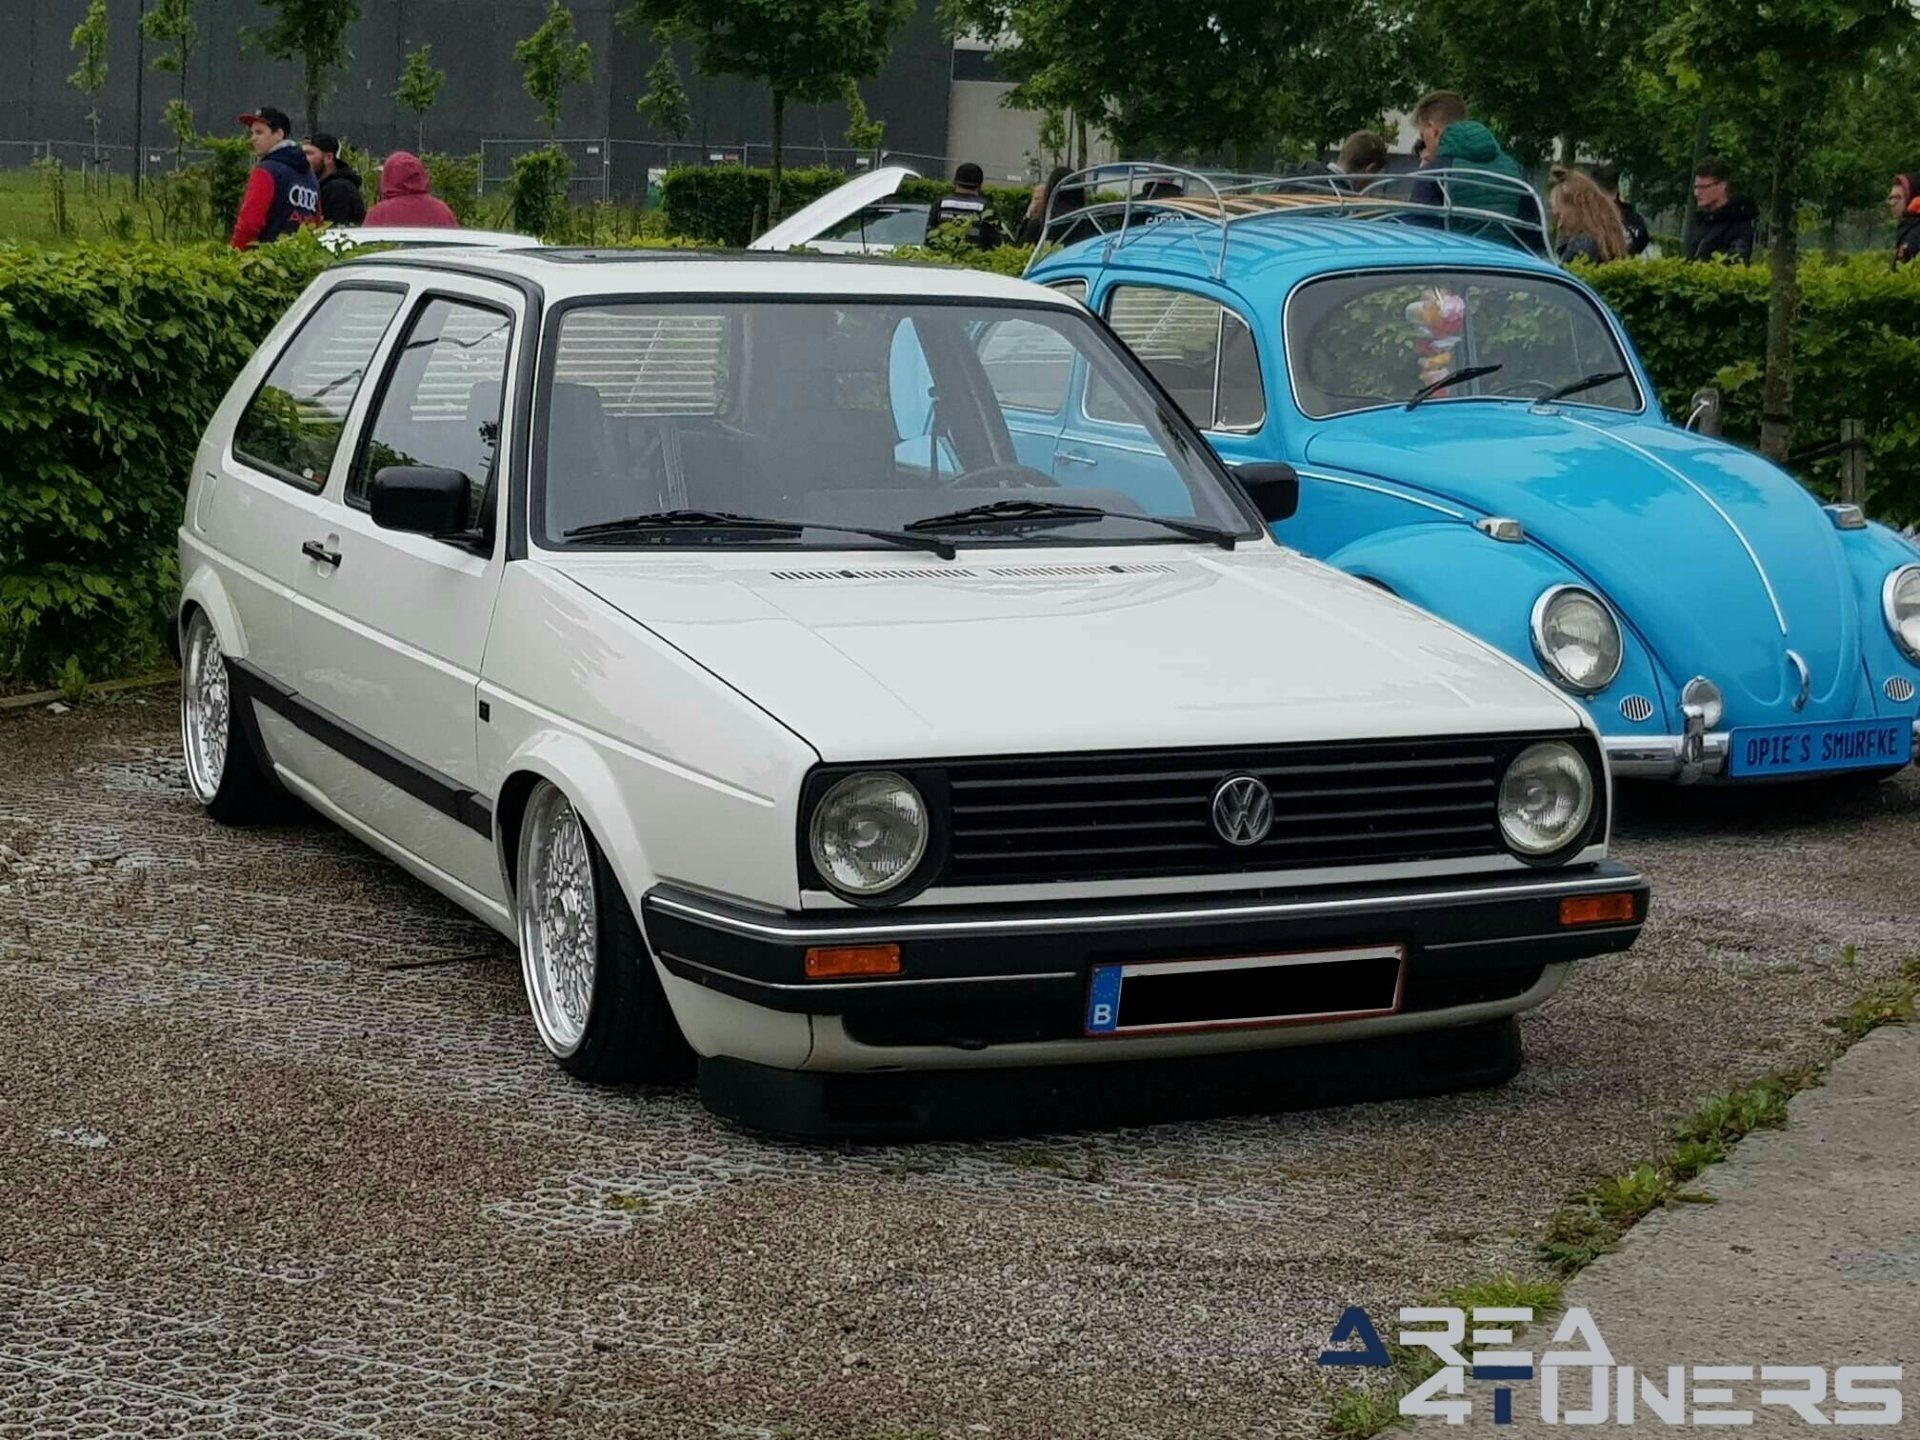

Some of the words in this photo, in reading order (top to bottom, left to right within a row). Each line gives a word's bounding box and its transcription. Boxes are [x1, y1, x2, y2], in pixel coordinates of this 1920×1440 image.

[1746, 734, 1811, 766] OPIE'S
[1822, 727, 1899, 761] SMURFKE
[1214, 778, 1272, 844] VW
[1093, 1003, 1112, 1025] B
